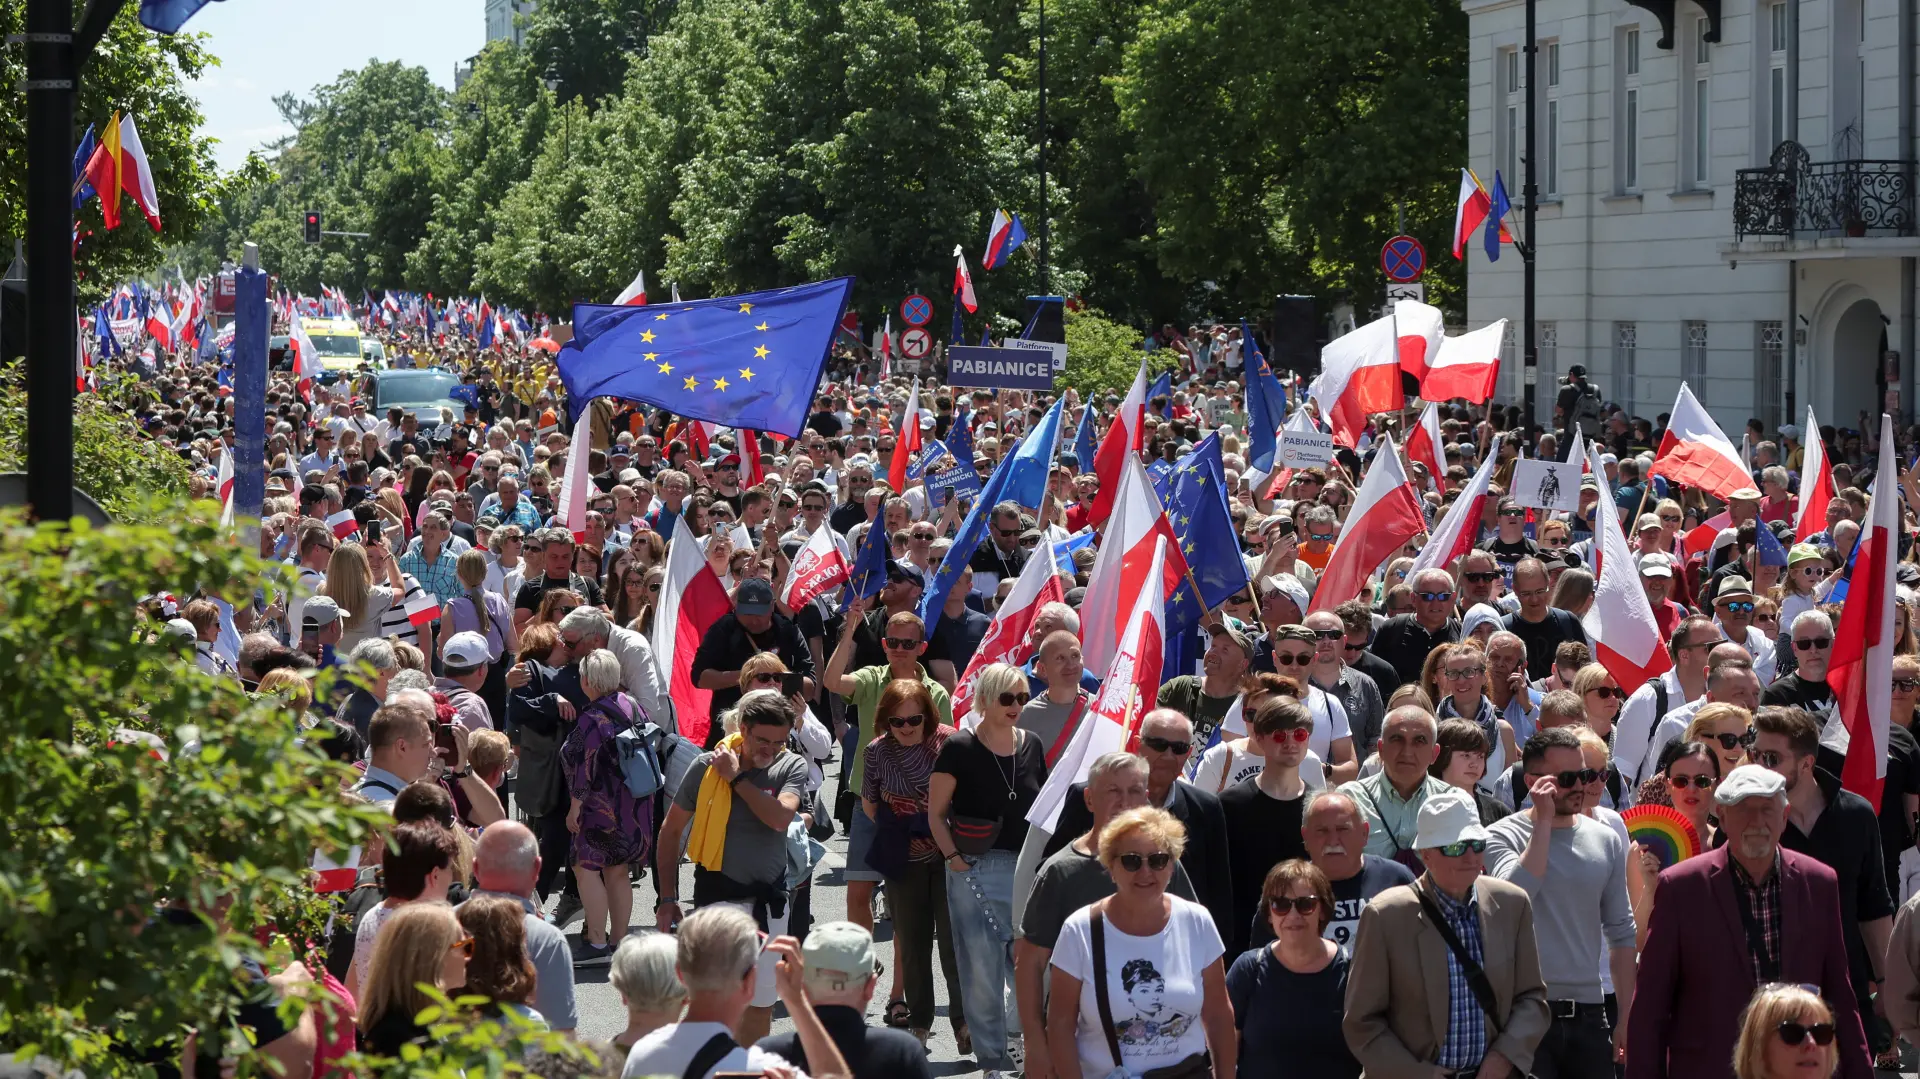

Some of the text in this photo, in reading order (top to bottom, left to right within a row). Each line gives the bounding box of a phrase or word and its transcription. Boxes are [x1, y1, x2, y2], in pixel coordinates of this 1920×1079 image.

[952, 359, 1049, 377] PABIANICE
[1283, 437, 1331, 453] PABIANICE
[930, 472, 973, 490] PABIANICKI
[935, 467, 963, 481] POWIAT
[1234, 766, 1261, 783] MAKE
